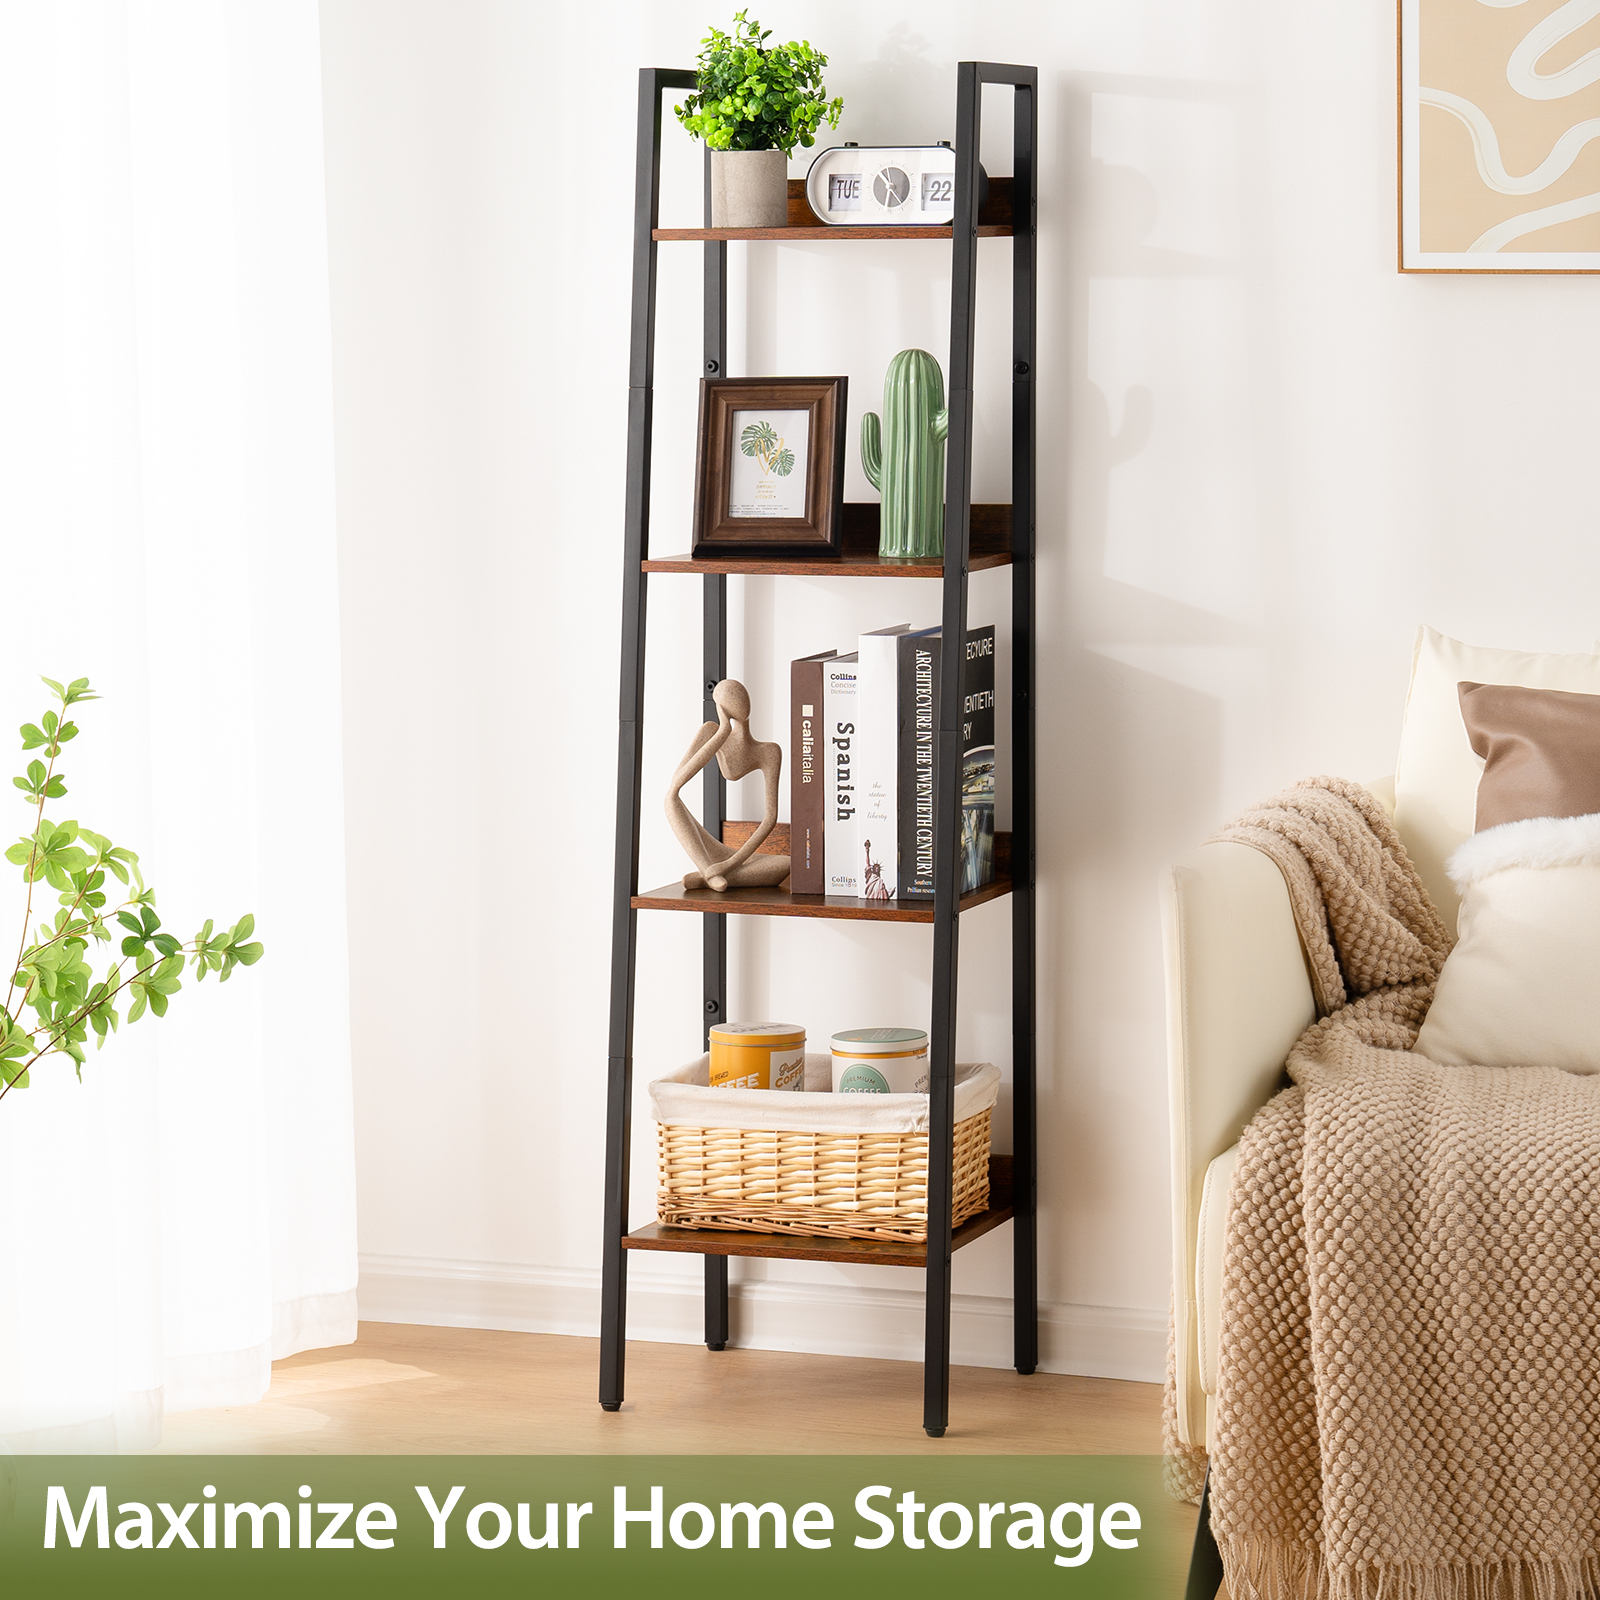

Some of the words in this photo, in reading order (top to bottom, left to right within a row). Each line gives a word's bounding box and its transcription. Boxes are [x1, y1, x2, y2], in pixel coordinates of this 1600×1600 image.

[837, 179, 860, 199] TUE
[930, 180, 952, 202] 22
[830, 673, 857, 681] Collins
[830, 681, 857, 689] Concise
[916, 730, 933, 743] IN
[802, 719, 814, 784] caliaitalia
[916, 743, 933, 765] THE
[832, 722, 855, 822] Spanish
[916, 766, 933, 827] TWENTIETH
[916, 828, 933, 878] CENTURY
[846, 1075, 876, 1085] PREMIUM
